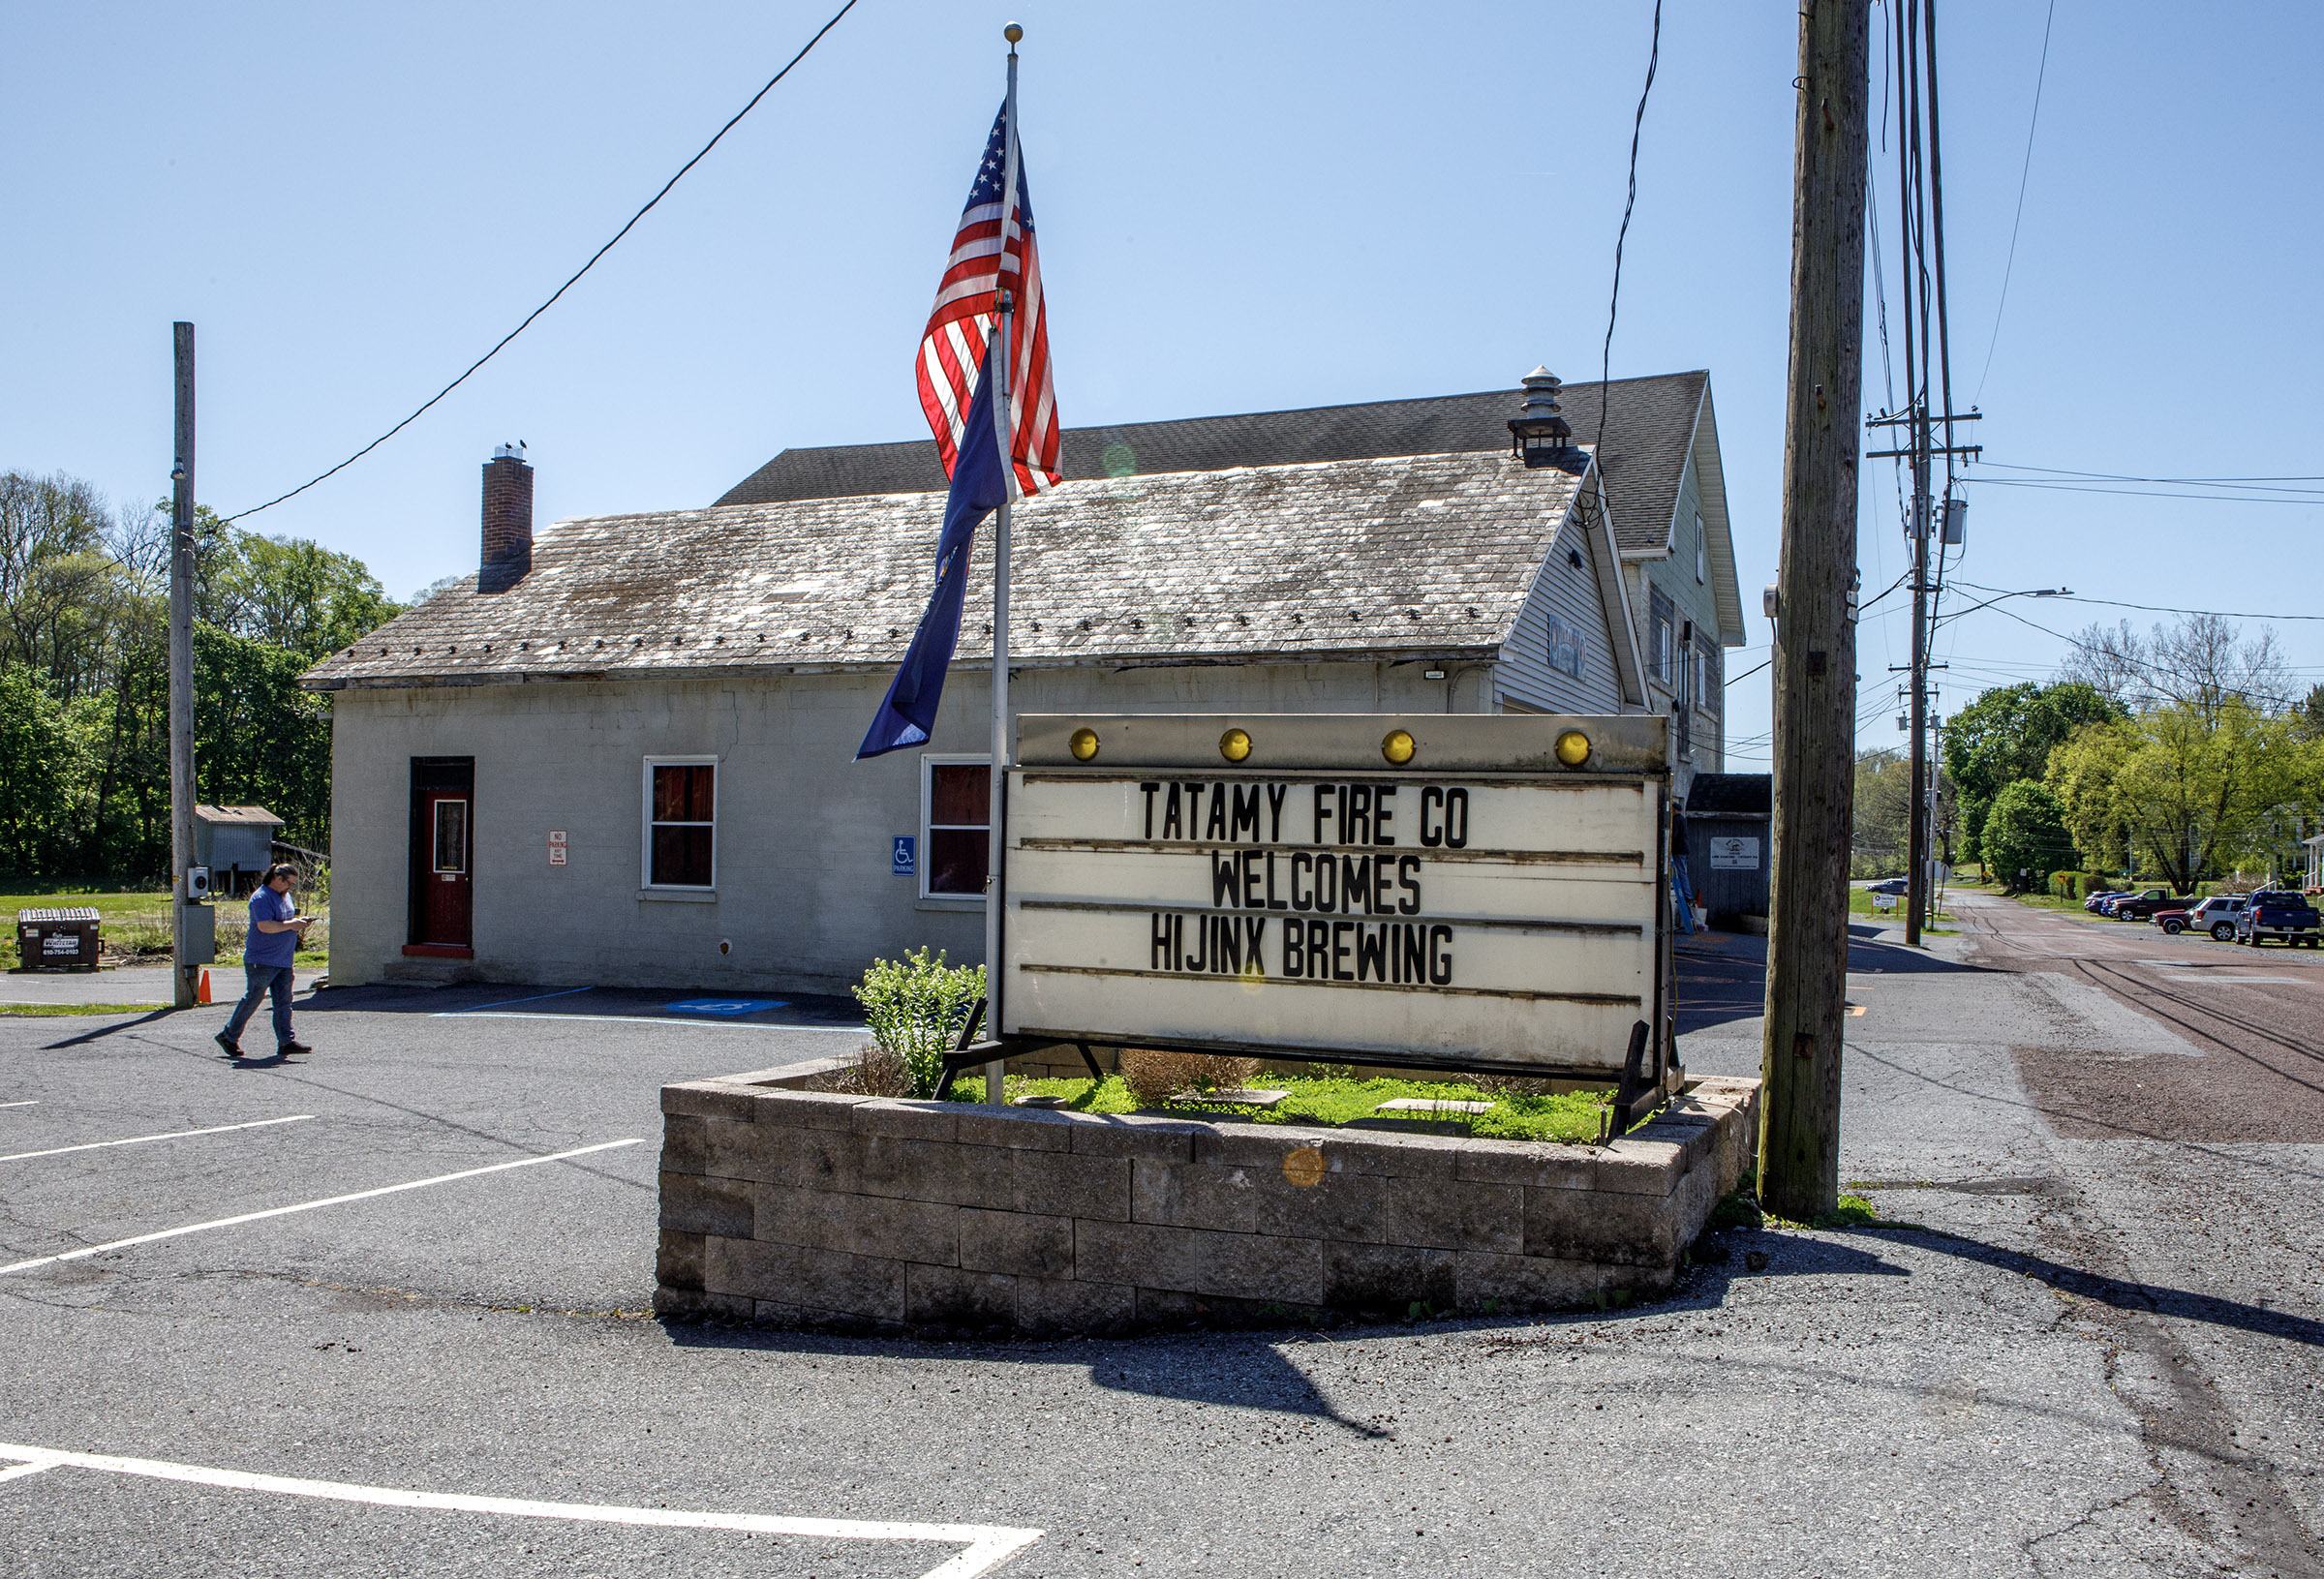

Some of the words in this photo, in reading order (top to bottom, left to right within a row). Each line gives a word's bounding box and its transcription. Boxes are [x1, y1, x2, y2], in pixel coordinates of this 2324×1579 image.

[1140, 781, 1287, 843] TATAMY
[1314, 783, 1397, 846] FIRE
[1420, 786, 1469, 849] CO
[1211, 849, 1422, 916] WELCOMES
[1151, 912, 1266, 976] HIJINX
[1282, 917, 1452, 986] BREWING
